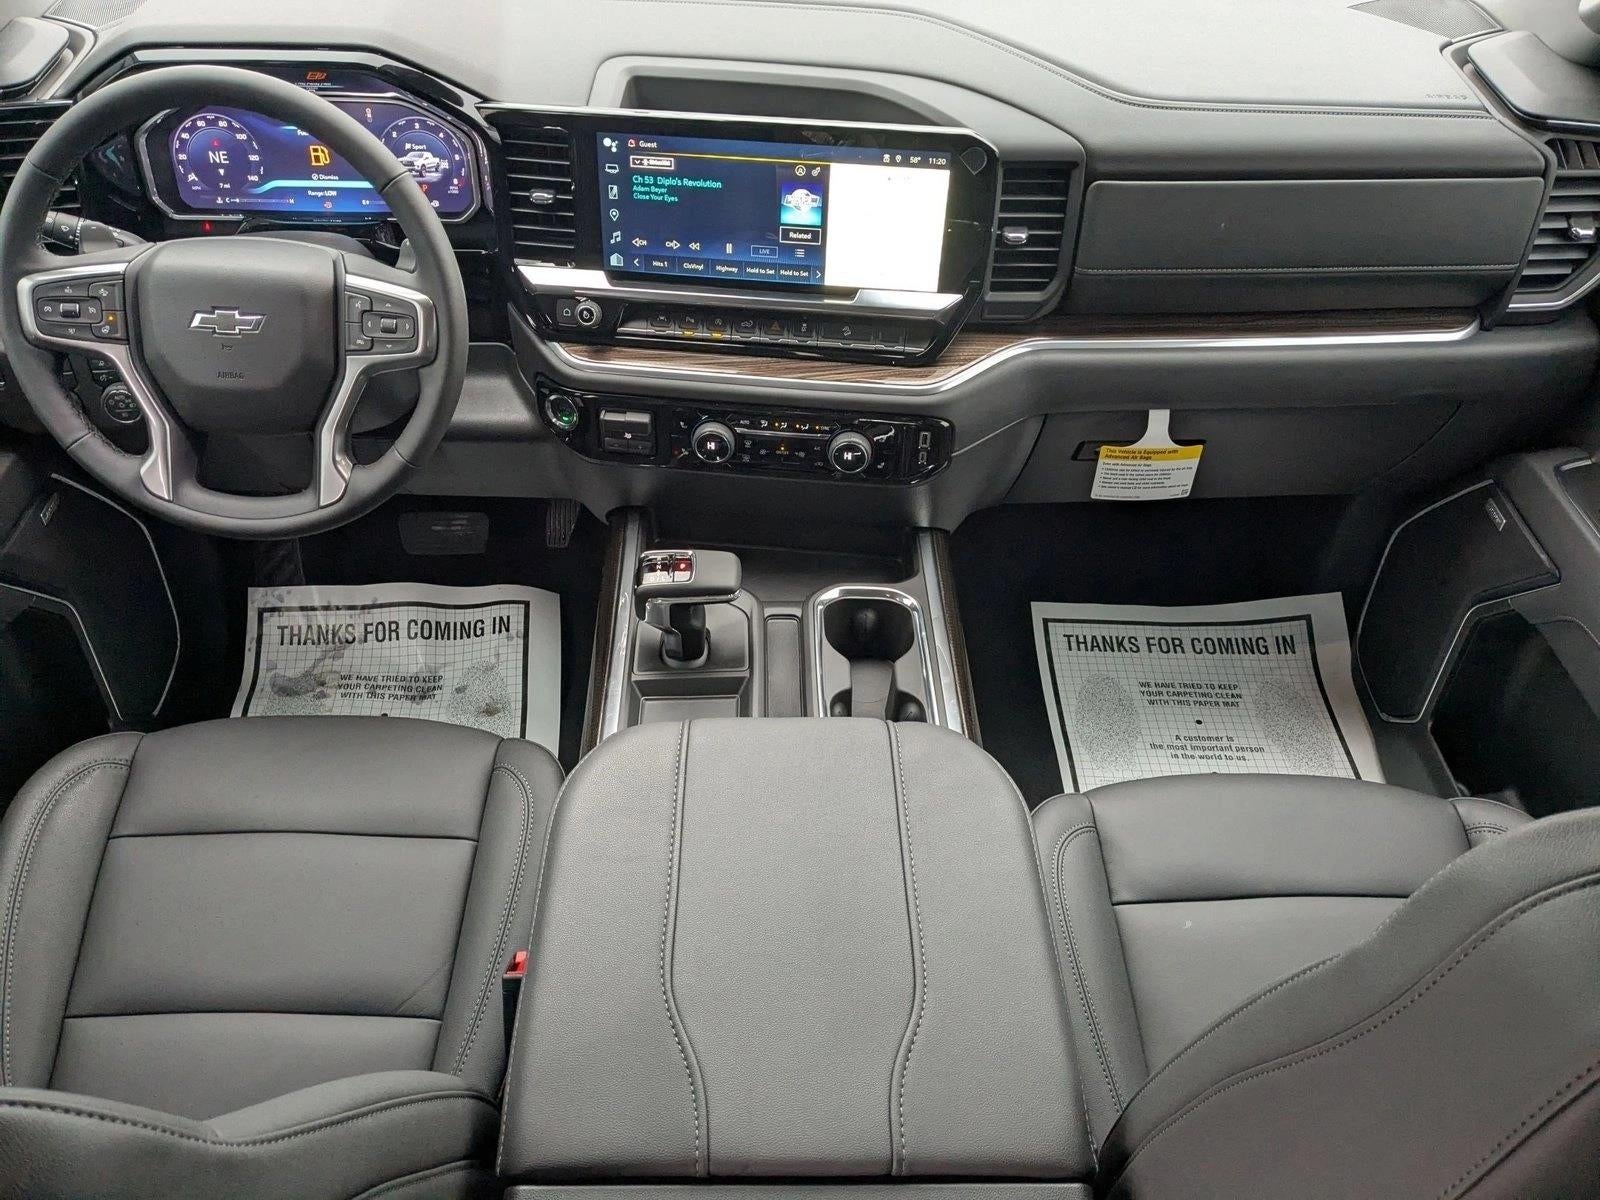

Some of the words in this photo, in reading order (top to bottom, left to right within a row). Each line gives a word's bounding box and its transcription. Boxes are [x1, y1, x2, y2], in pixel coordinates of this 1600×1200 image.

[412, 143, 427, 151] Sport
[208, 151, 229, 163] NE
[928, 157, 946, 165] 11:20
[632, 175, 643, 183] Ch
[644, 176, 654, 184] 53
[657, 176, 682, 187] Diplo's
[683, 178, 722, 188] Revolution
[651, 186, 667, 194] Beyer
[664, 195, 678, 203] Eyes
[789, 232, 812, 240] Related
[716, 265, 738, 273] Highway
[276, 623, 357, 646] THANKS
[363, 620, 400, 643] FOR
[406, 618, 485, 641] COMING
[492, 615, 511, 635] IN
[1062, 634, 1140, 654] THANKS
[1146, 636, 1186, 655] FOR
[1190, 636, 1270, 656] COMING
[1275, 635, 1296, 655] IN
[422, 676, 444, 684] KEEP
[364, 683, 413, 693] CARPETING
[416, 684, 443, 693] CLEAN
[1178, 682, 1202, 690] TRIED
[366, 692, 385, 700] THIS
[388, 693, 416, 701] PAPER
[419, 693, 437, 701] MAT
[1166, 690, 1213, 698] CARPETING
[1190, 744, 1233, 752] important
